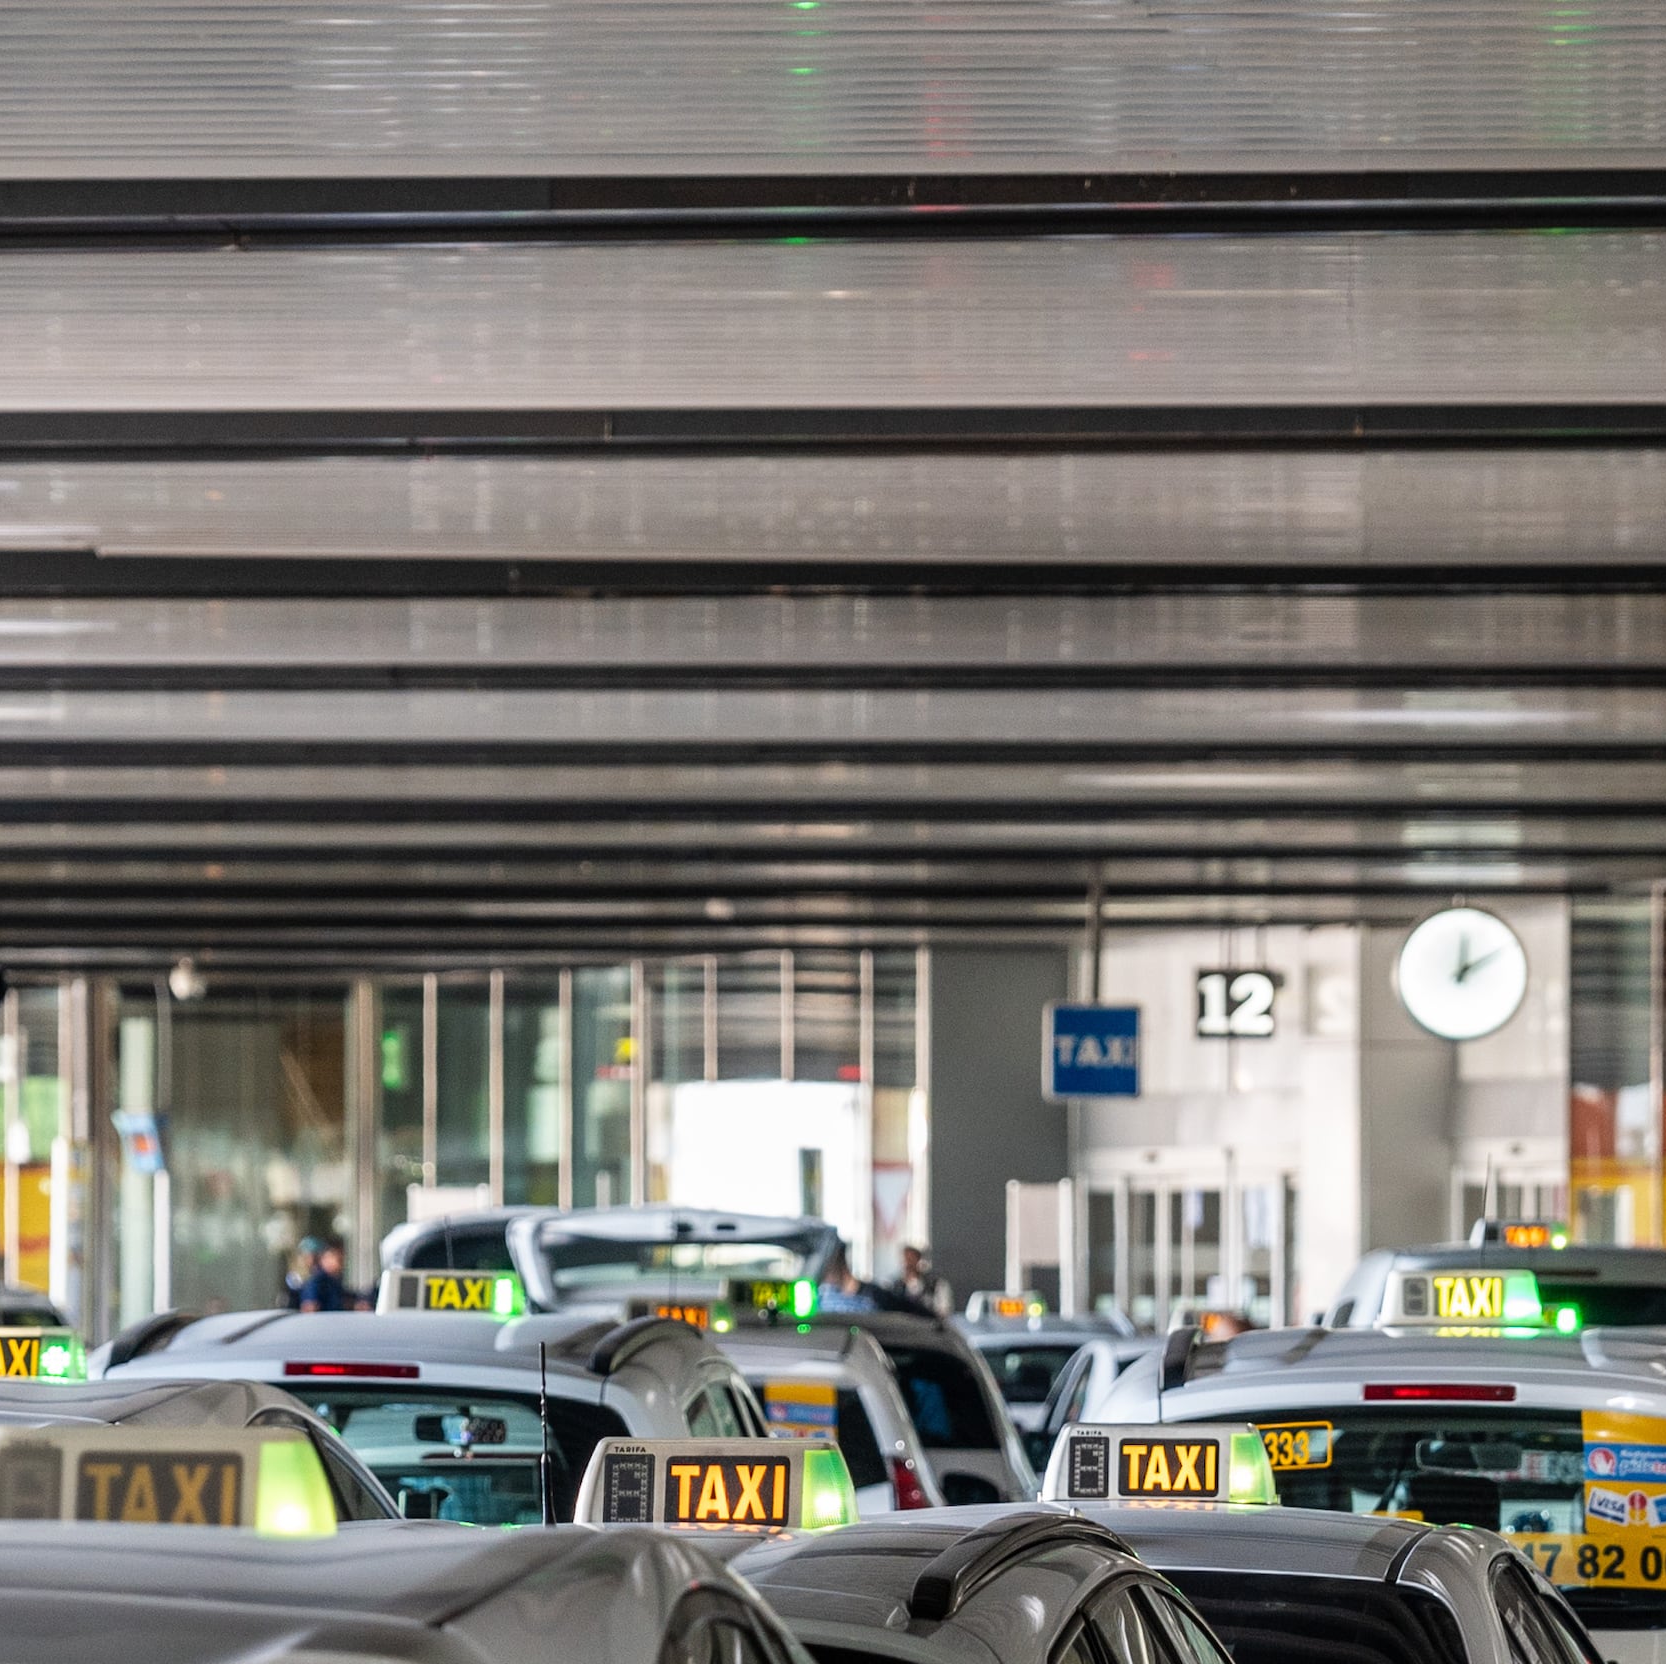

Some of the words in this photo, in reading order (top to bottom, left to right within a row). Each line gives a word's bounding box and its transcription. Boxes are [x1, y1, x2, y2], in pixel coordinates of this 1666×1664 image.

[1197, 972, 1274, 1035] 12
[425, 1278, 490, 1309] TAXI
[1434, 1277, 1503, 1317] TAXI
[1122, 1444, 1217, 1491] TAXI
[1264, 1430, 1310, 1466] 333
[84, 1464, 241, 1526] TAXI
[670, 1464, 786, 1520] TAXI
[1596, 1497, 1626, 1513] VISA
[1577, 1544, 1626, 1580] 82
